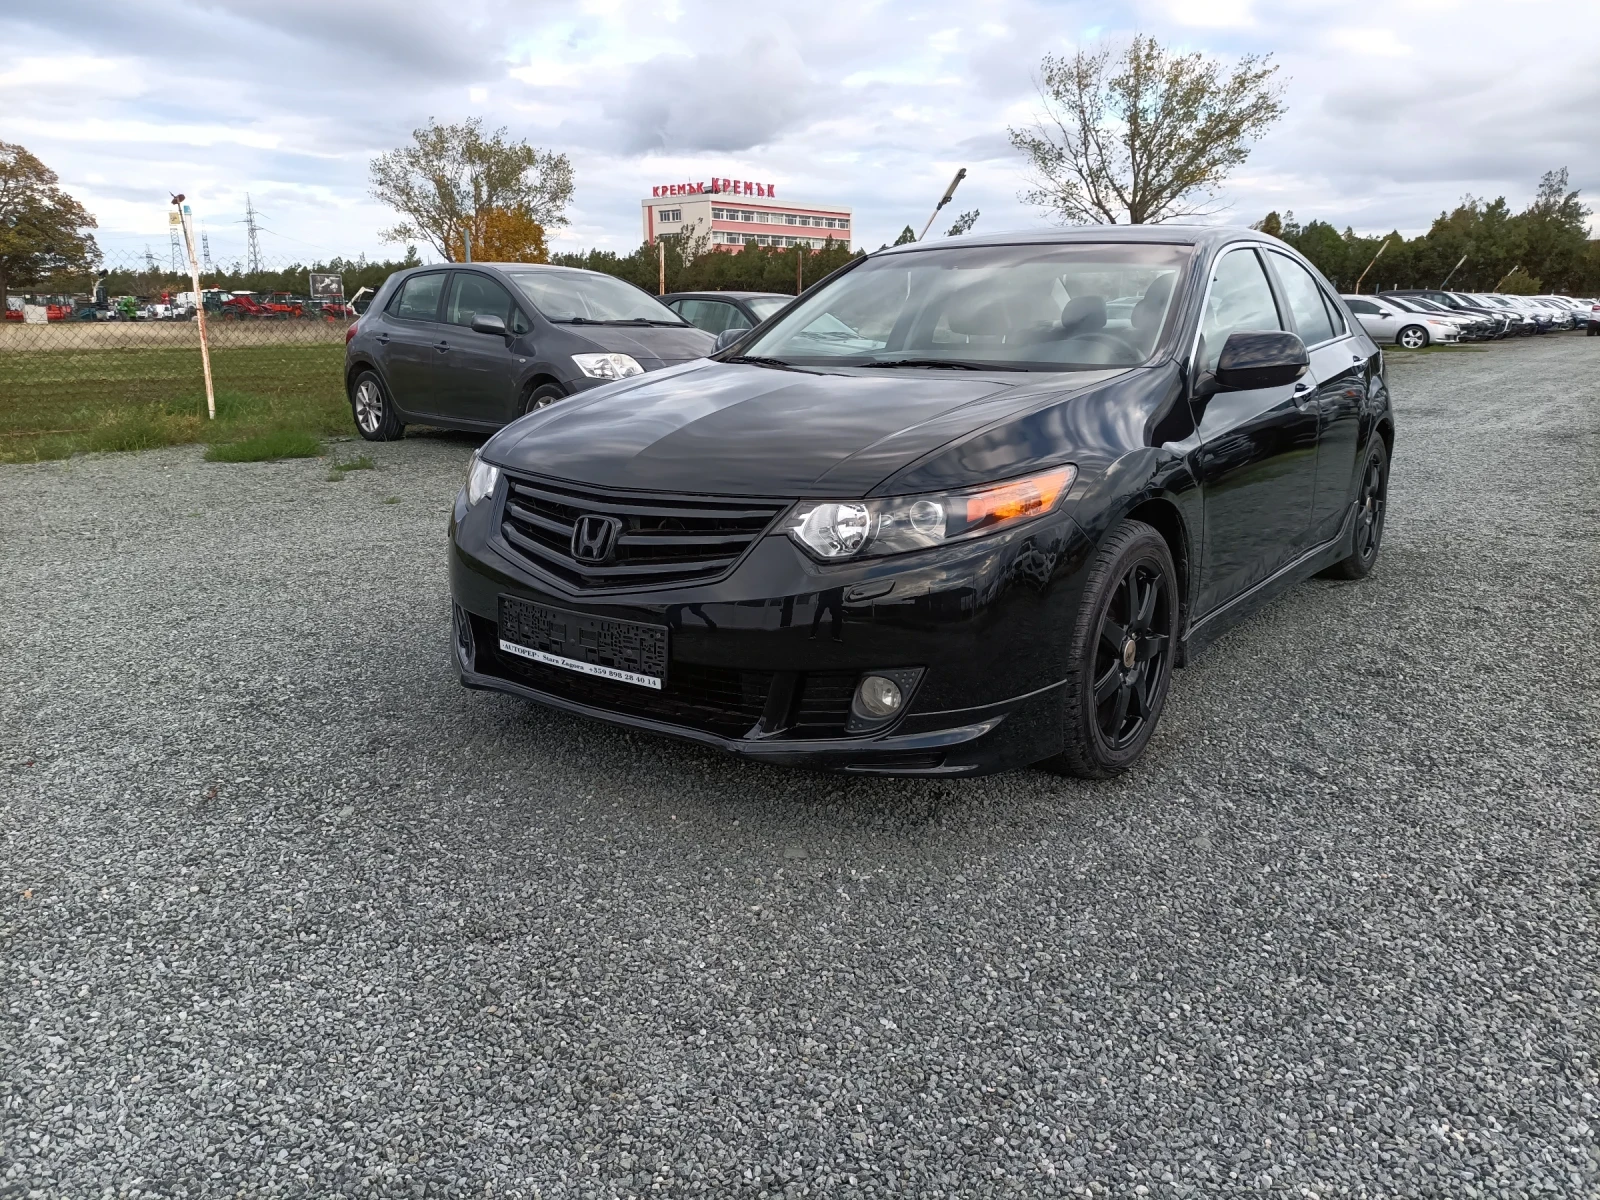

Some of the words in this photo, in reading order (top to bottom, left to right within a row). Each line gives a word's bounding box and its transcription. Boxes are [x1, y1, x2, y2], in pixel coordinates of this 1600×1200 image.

[652, 181, 704, 197] КРЕМЪК
[711, 177, 775, 198] КРЕМЪК
[588, 667, 607, 675] +359
[608, 670, 623, 679] 898
[624, 673, 634, 681] 28
[635, 676, 645, 684] 40
[647, 678, 657, 686] 14
